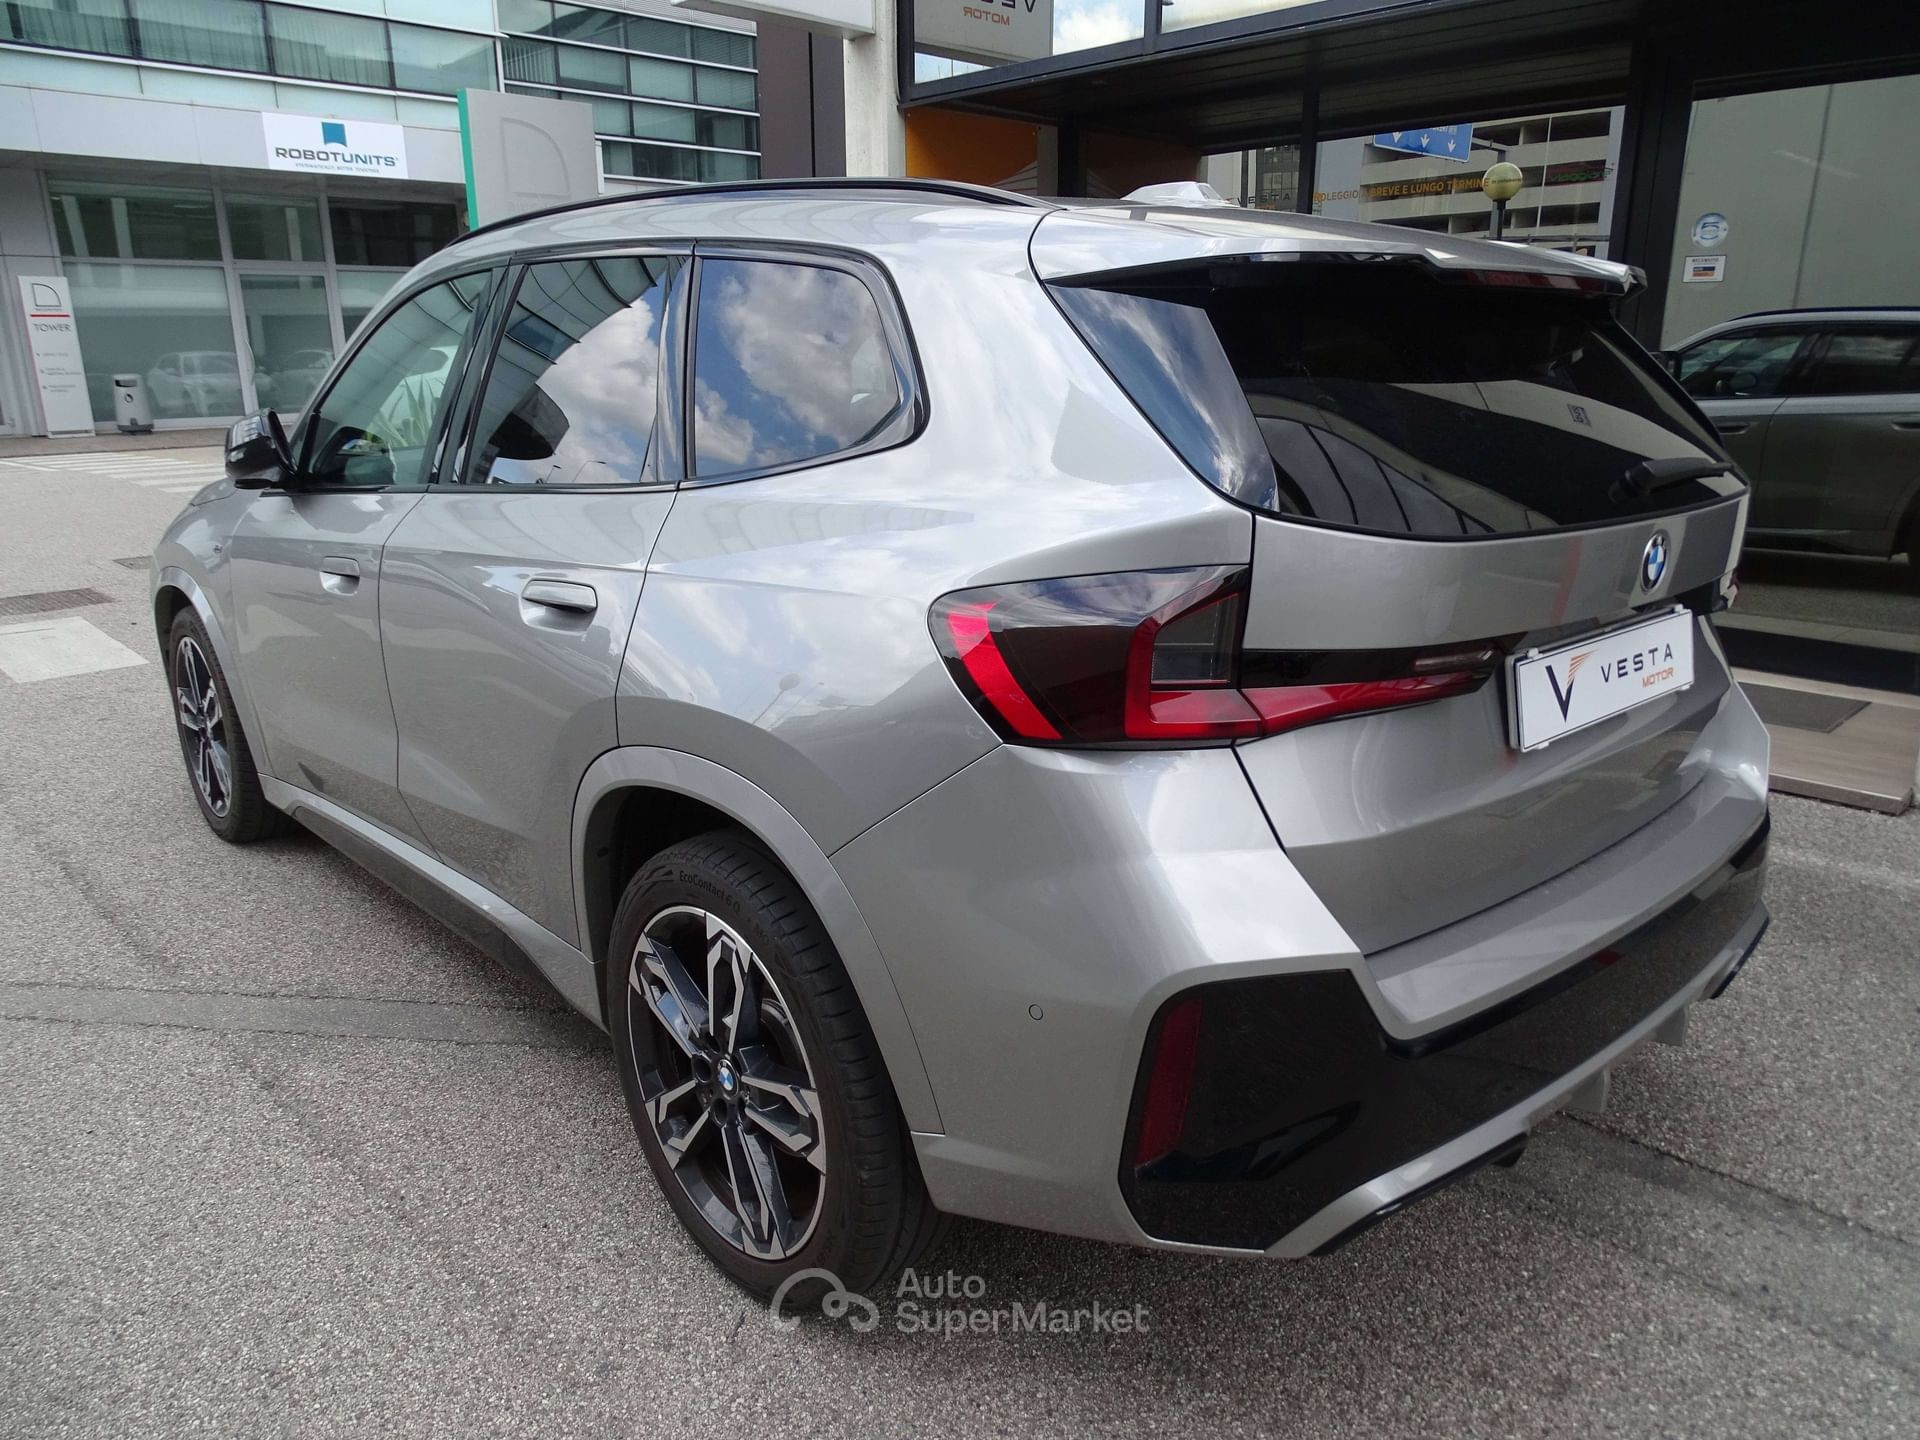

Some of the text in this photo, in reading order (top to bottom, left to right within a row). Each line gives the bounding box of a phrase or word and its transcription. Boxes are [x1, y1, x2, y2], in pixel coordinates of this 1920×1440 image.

[275, 147, 396, 167] ROBOTUNITS
[1411, 182, 1444, 193] LUNGO
[1446, 177, 1489, 189] TERMINE
[33, 323, 71, 332] TOWER
[1601, 643, 1673, 683] VESTA
[1642, 667, 1674, 688] MOTOR
[680, 870, 725, 899] EcoContact
